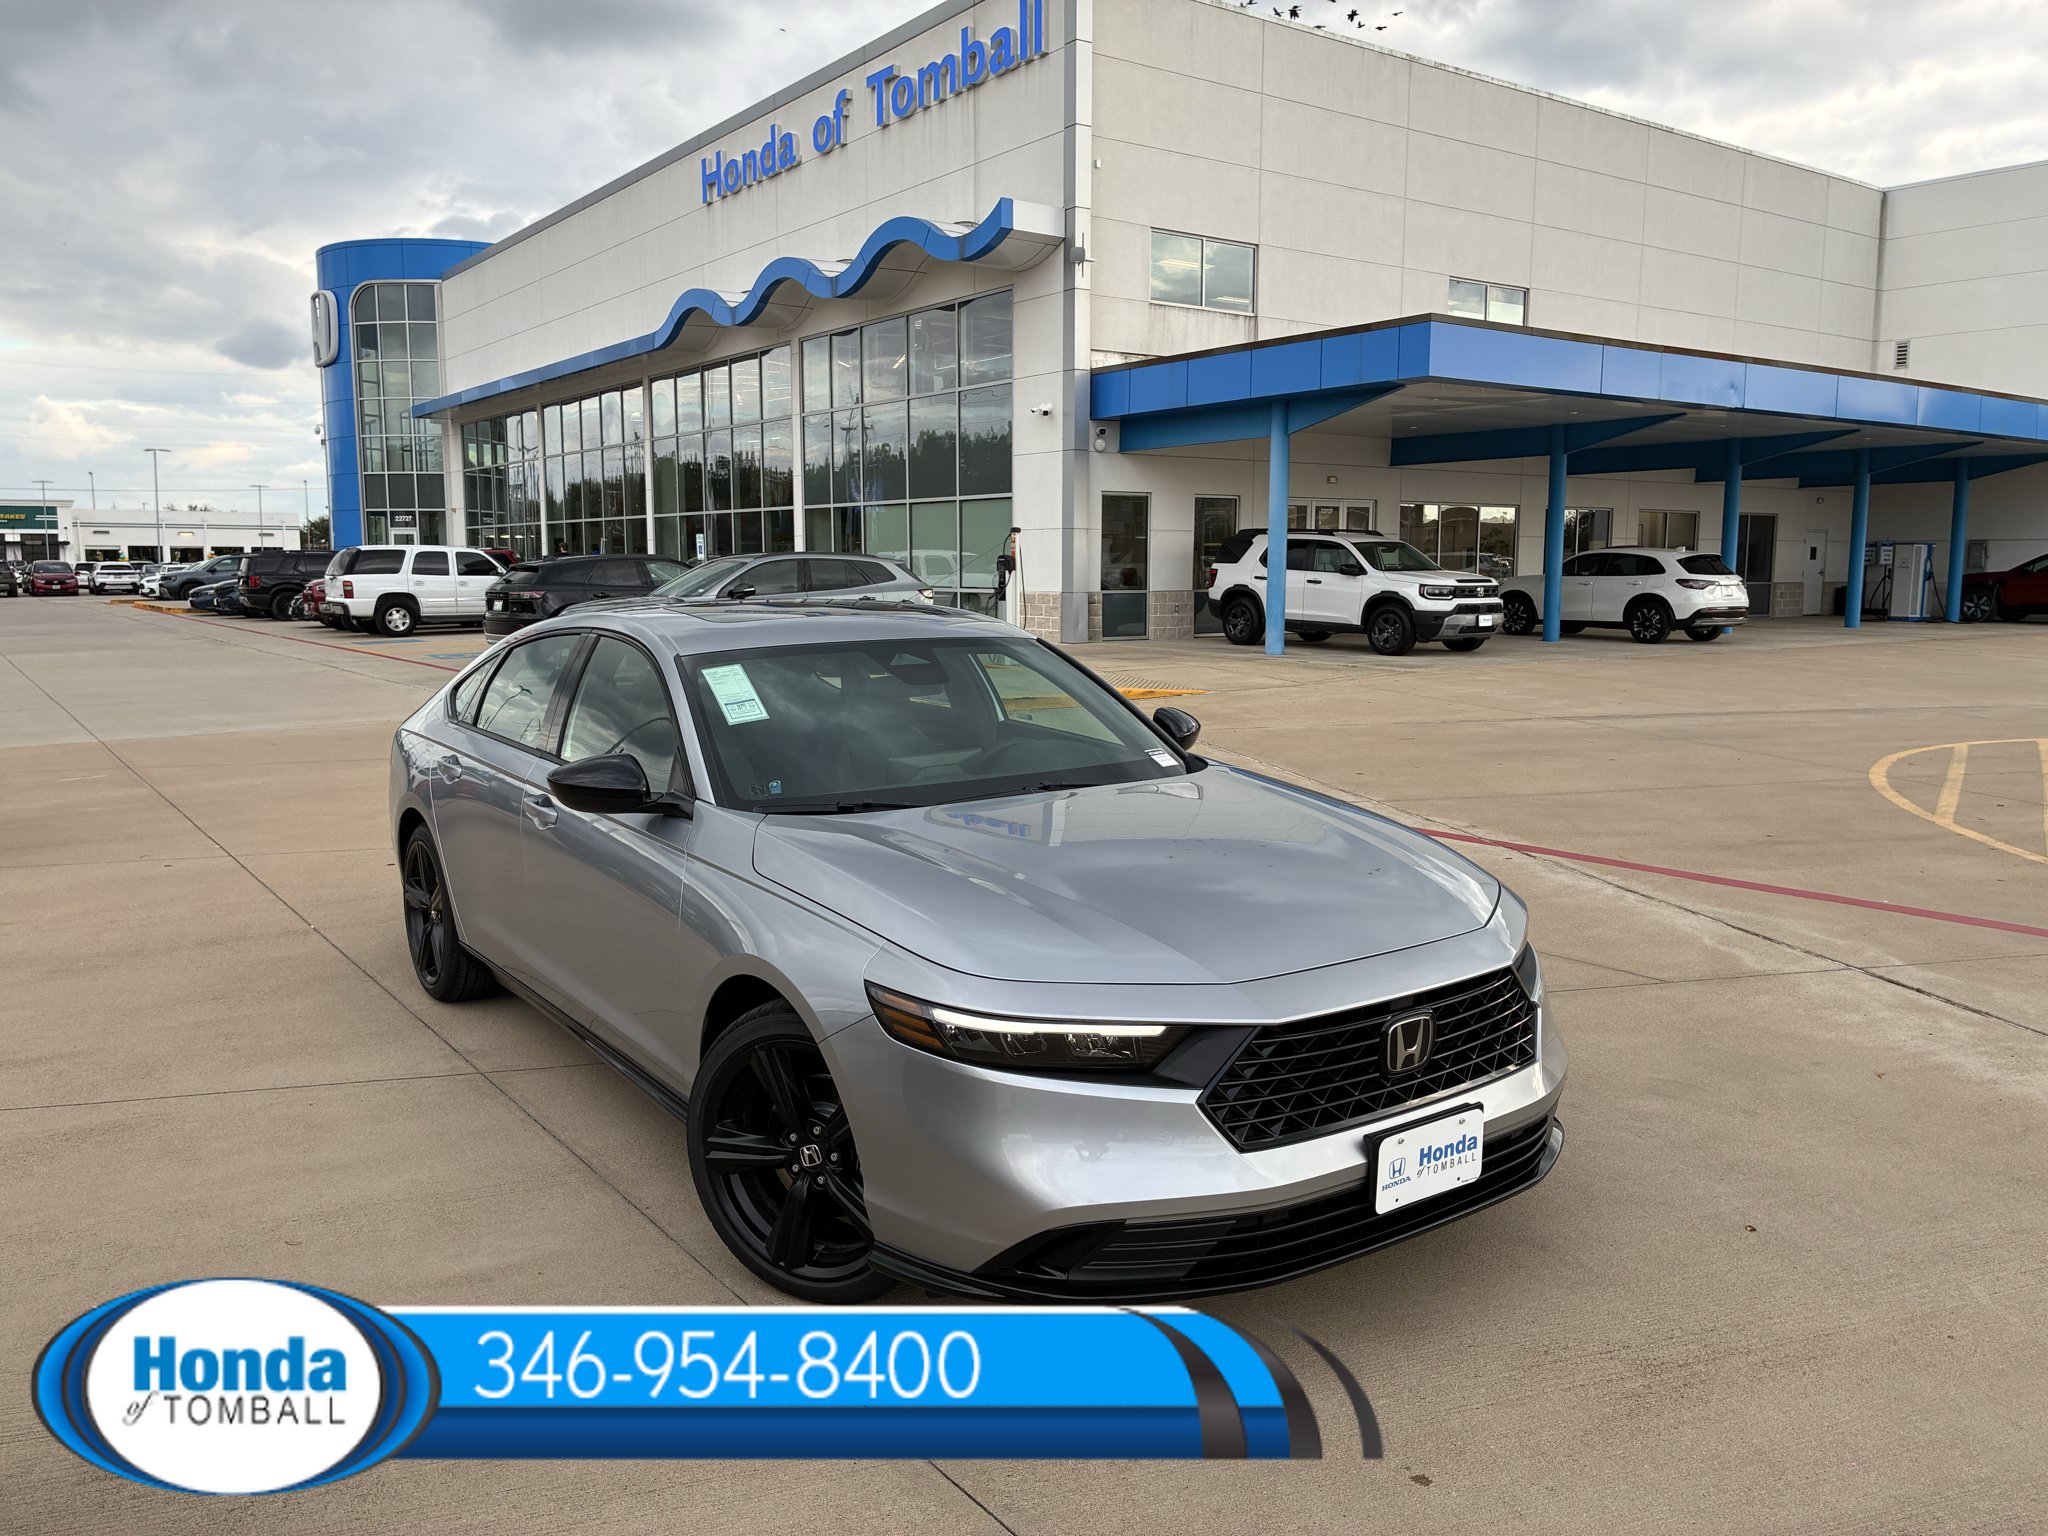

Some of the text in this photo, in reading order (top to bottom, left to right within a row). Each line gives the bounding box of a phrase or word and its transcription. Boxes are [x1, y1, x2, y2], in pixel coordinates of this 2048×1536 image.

[701, 0, 1048, 205] Honda of Tomball
[1419, 1134, 1478, 1167] Honda
[1416, 1153, 1477, 1179] of TOMBALL
[1381, 1176, 1411, 1191] HONDA
